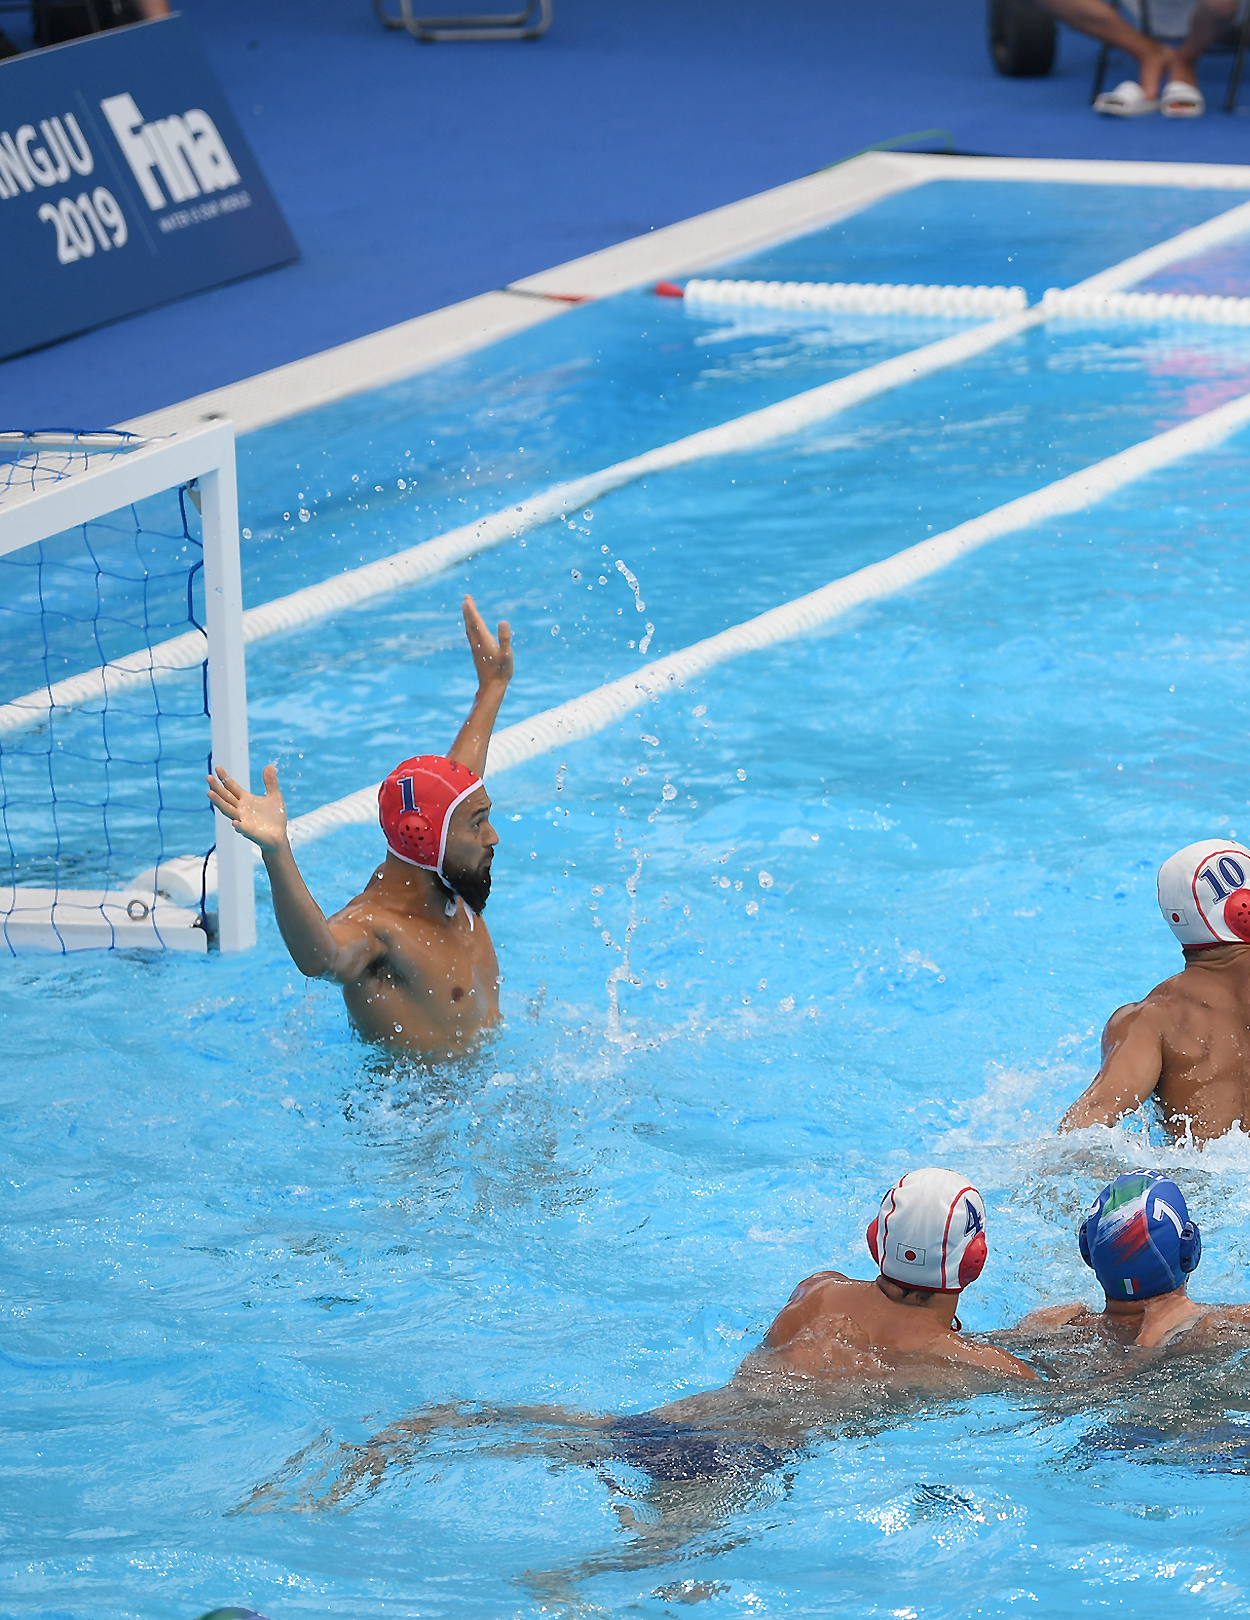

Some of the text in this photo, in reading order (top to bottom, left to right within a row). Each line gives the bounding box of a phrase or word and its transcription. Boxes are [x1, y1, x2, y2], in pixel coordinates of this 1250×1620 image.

[38, 186, 128, 264] 2019
[397, 776, 420, 813] 1
[1198, 855, 1246, 905] 10
[963, 1196, 983, 1237] 4
[1153, 1197, 1184, 1239] 7
